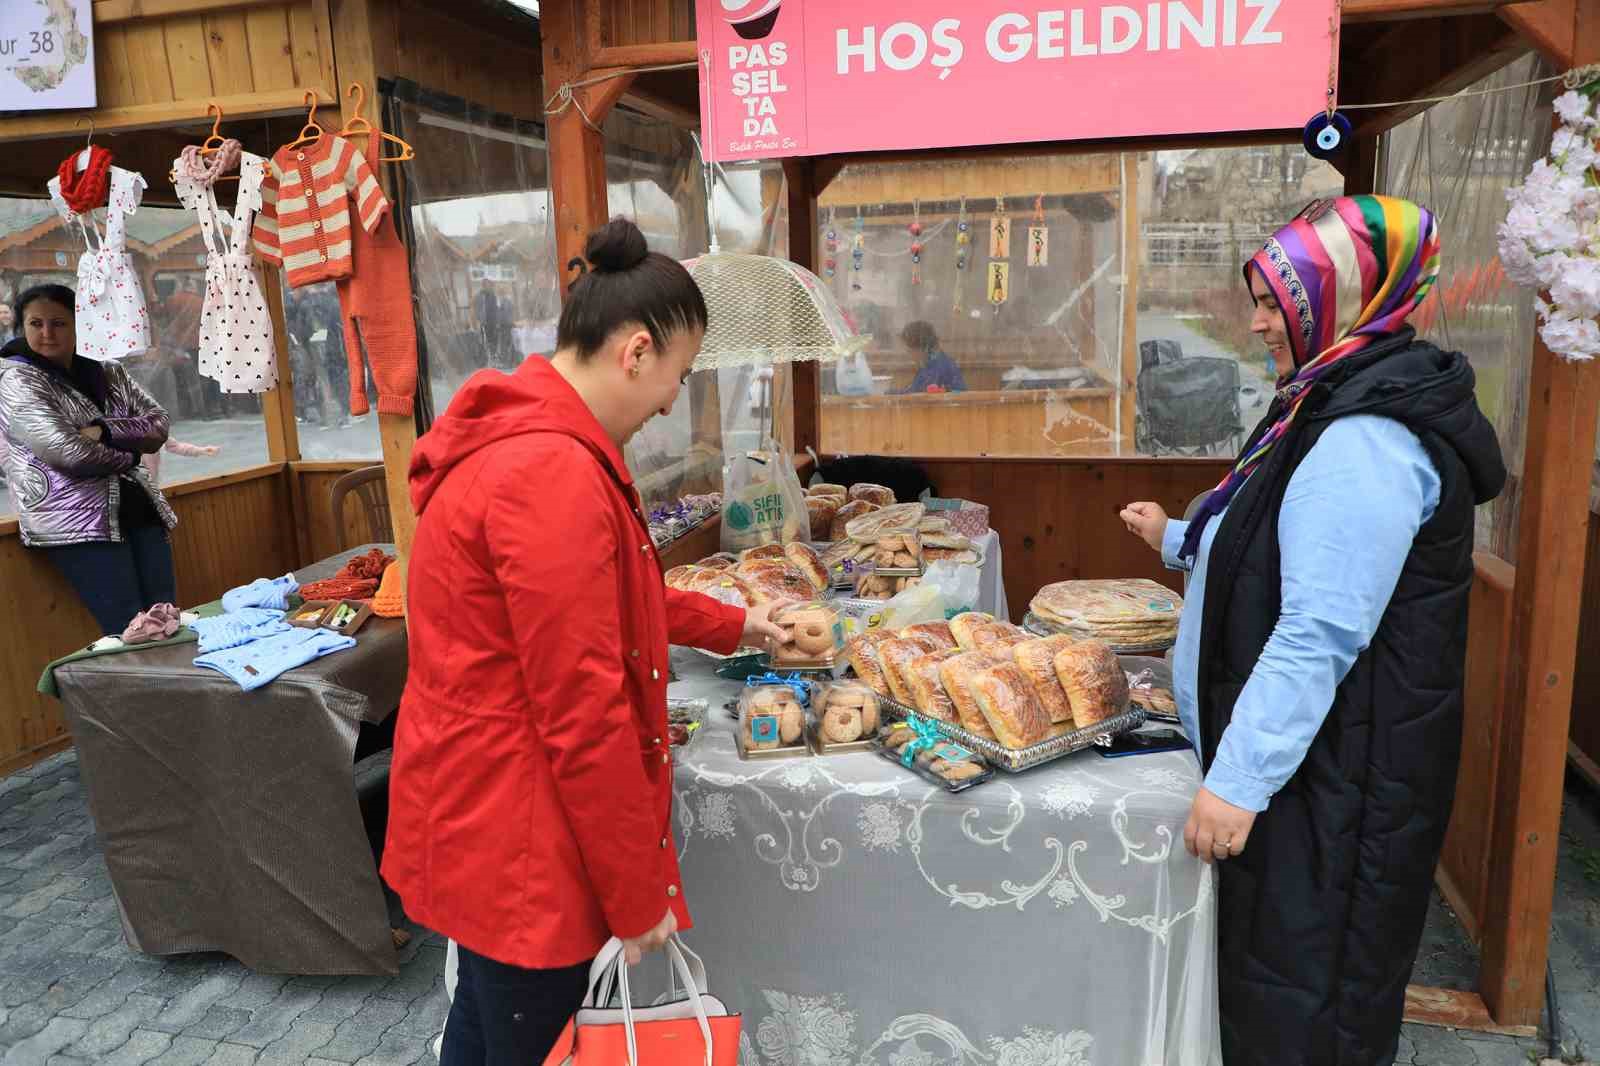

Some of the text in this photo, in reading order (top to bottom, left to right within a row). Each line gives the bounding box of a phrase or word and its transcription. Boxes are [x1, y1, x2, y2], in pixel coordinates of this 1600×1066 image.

[728, 41, 788, 69] PAS
[836, 18, 964, 80] HOŞ
[732, 70, 787, 96] SEL
[742, 95, 777, 116] TA
[743, 117, 778, 137] DA
